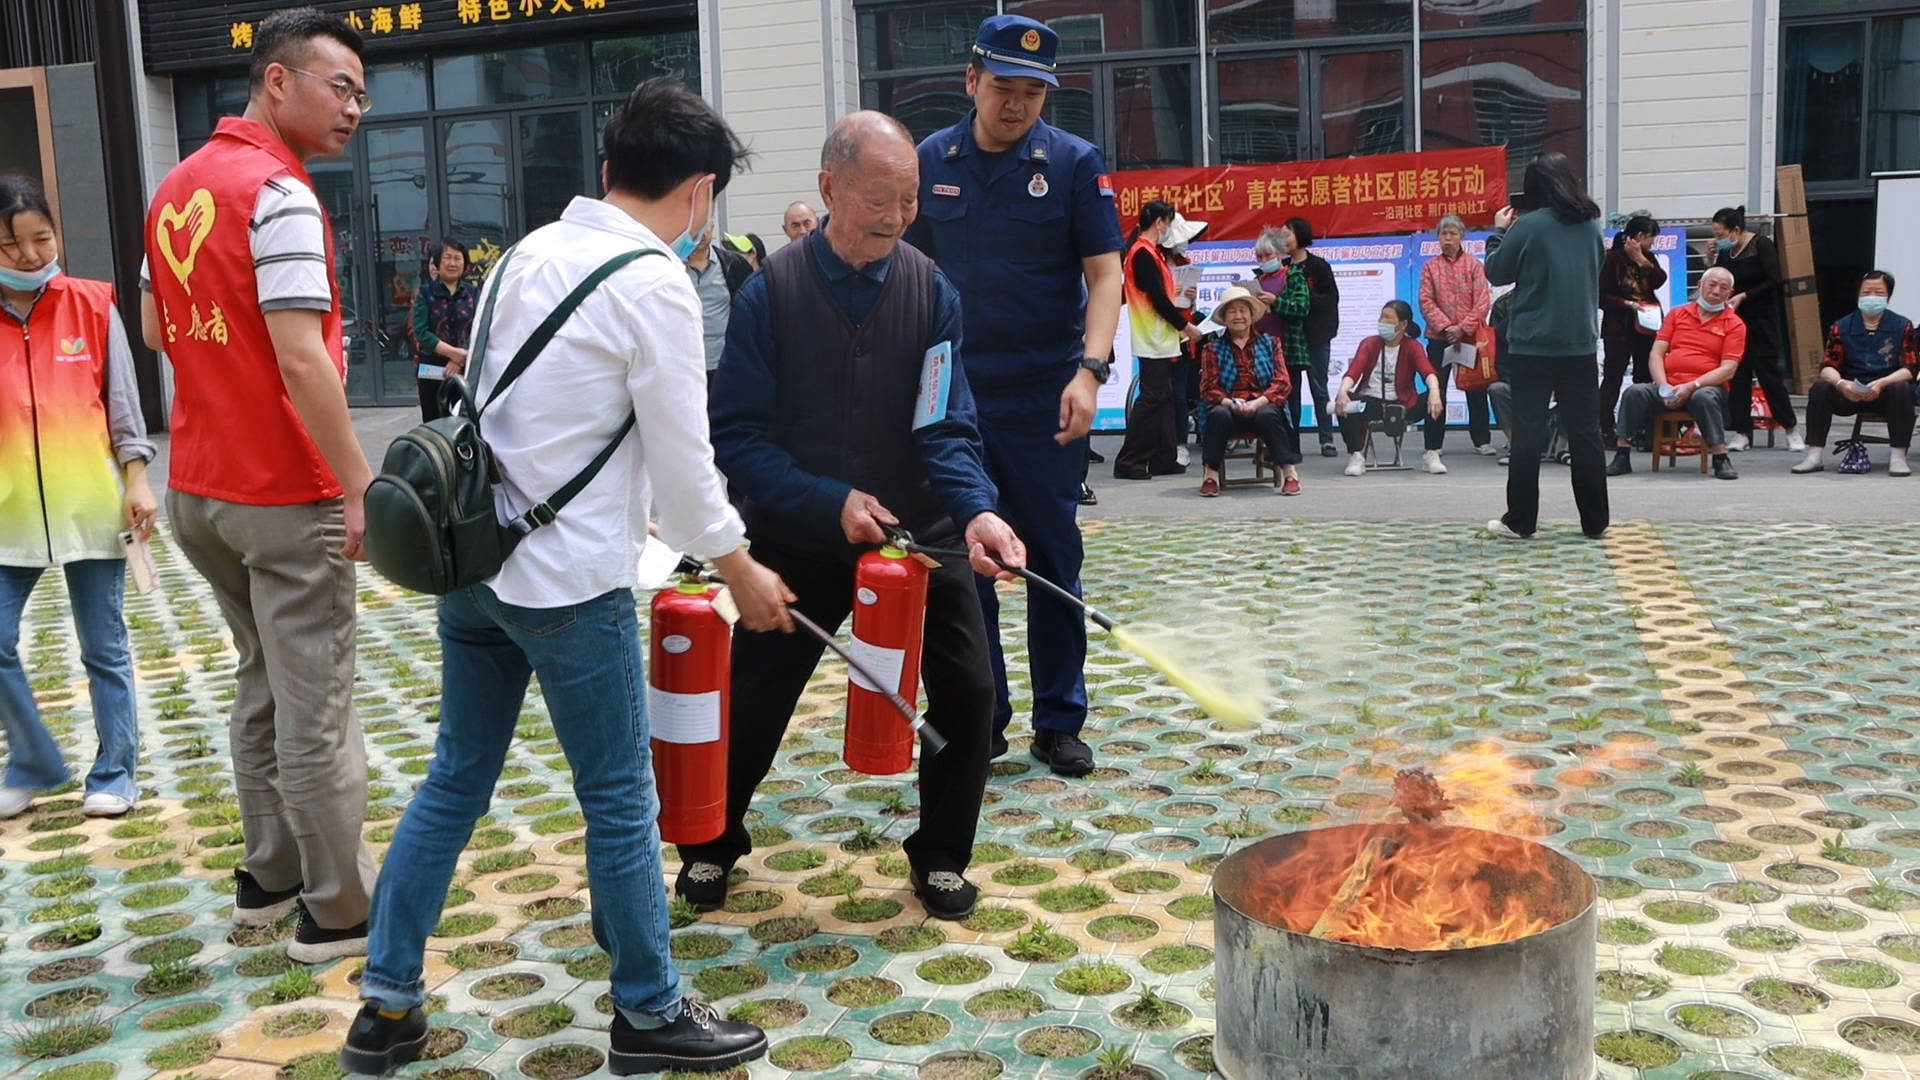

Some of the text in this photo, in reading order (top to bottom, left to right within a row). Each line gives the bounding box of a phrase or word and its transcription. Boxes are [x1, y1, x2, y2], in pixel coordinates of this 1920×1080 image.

[1113, 164, 1485, 216] 创美好社区”青年志愿者社区服务行动
